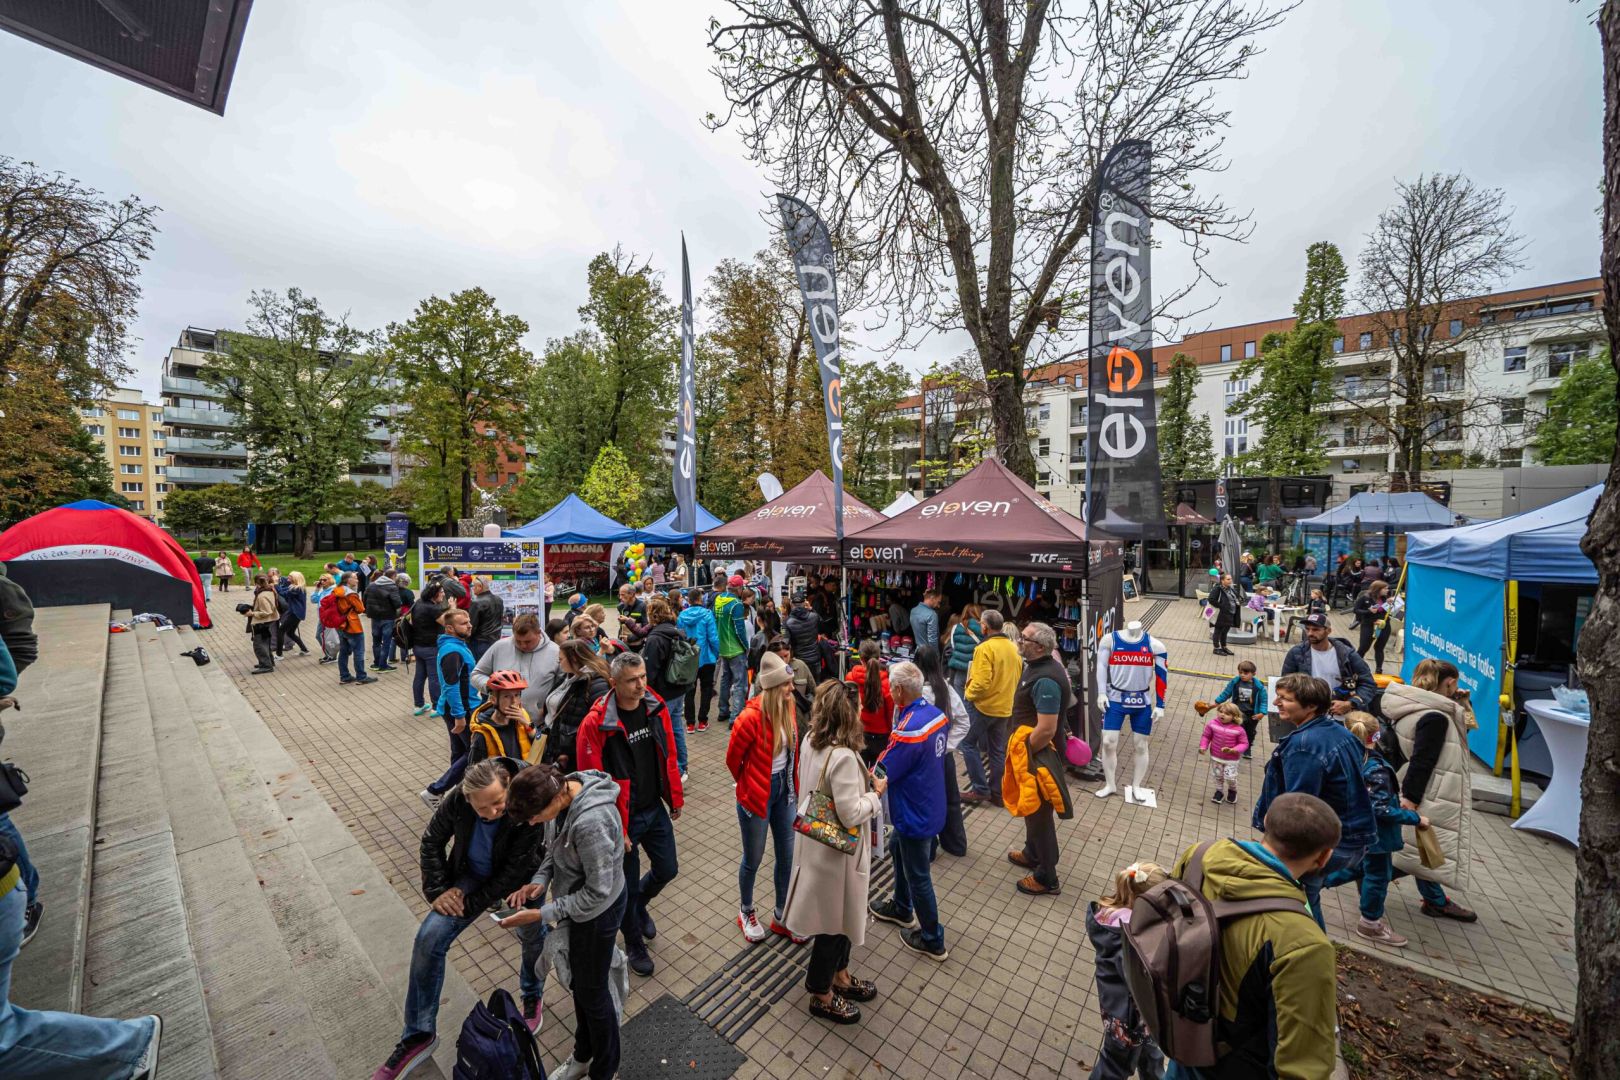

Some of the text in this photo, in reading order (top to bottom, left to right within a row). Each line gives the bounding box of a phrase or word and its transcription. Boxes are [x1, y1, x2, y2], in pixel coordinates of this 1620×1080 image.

[561, 544, 605, 553] MAGNA
[812, 546, 828, 554] TKF
[1030, 553, 1059, 564] TKF
[1113, 654, 1152, 663] SLOVAKIA
[1445, 640, 1468, 664] energiu
[1468, 652, 1477, 669] na
[1477, 652, 1496, 681] fotke
